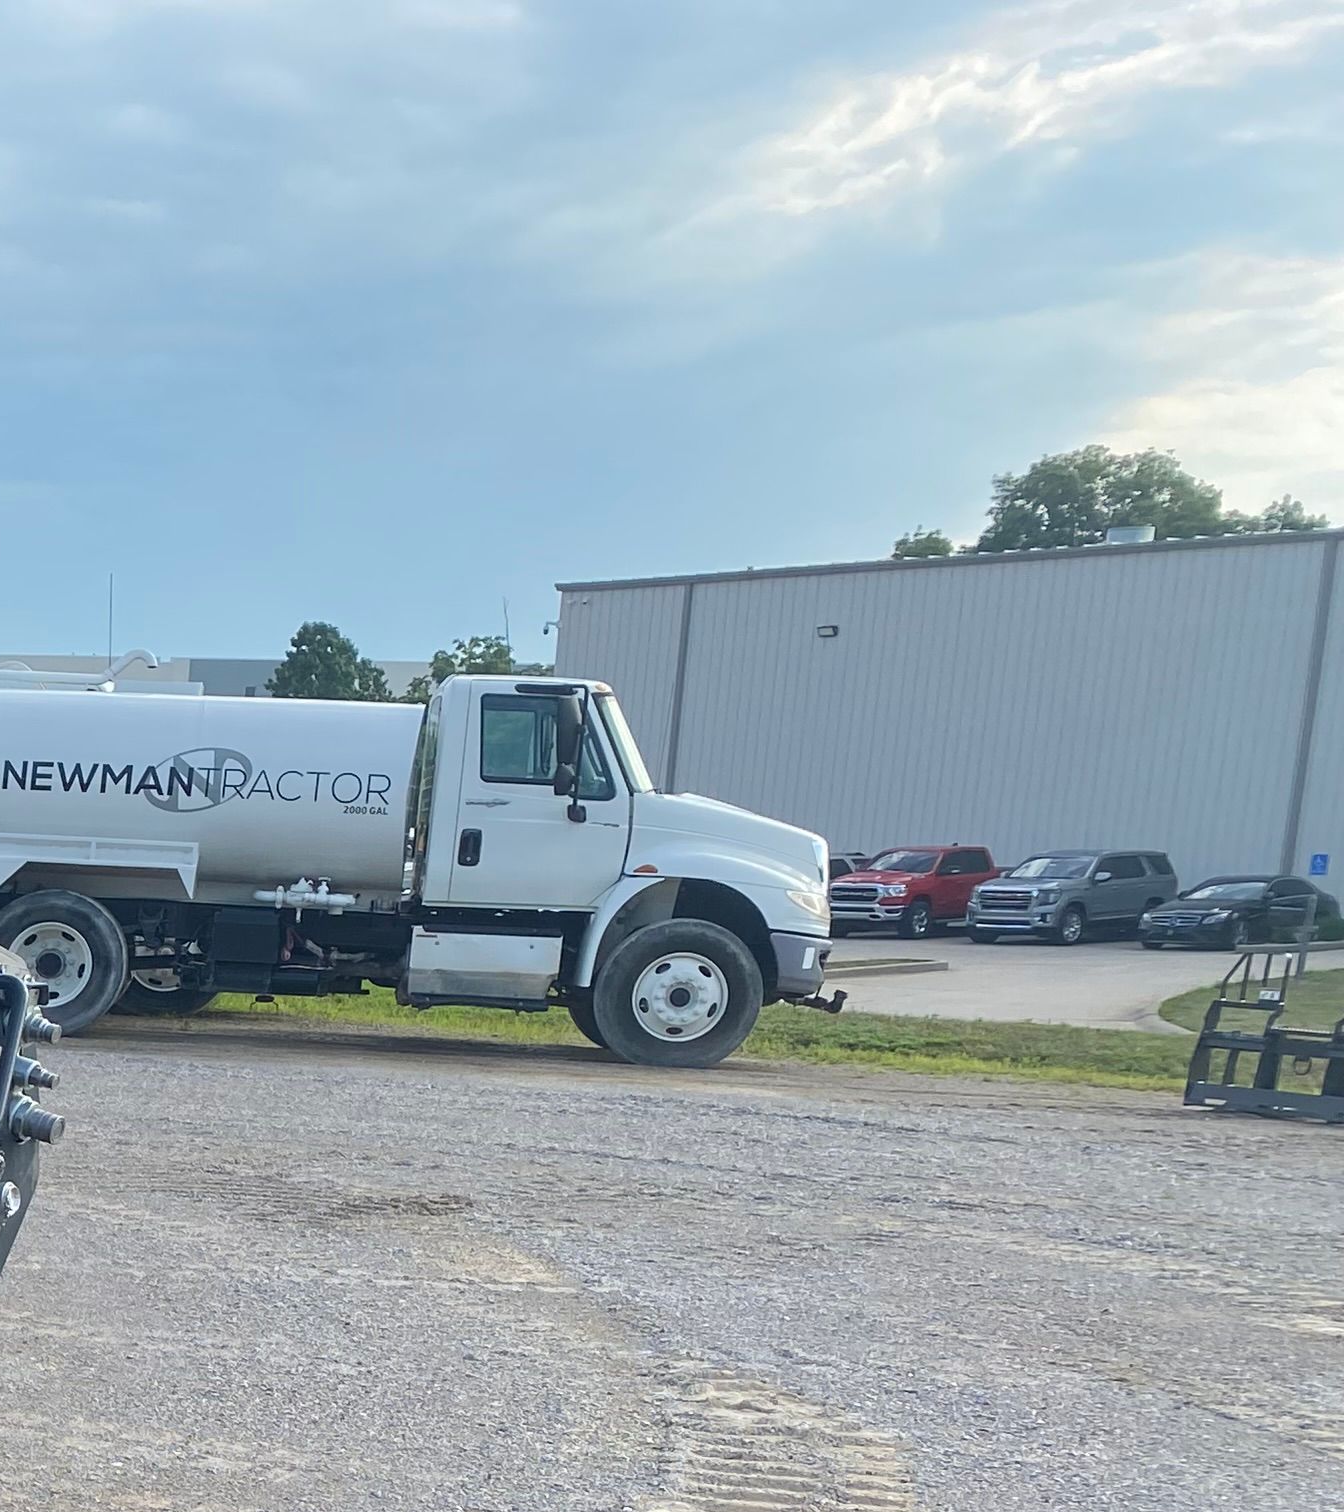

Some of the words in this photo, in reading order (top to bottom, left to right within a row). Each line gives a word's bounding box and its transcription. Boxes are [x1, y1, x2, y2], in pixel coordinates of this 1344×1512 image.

[1, 759, 392, 805] NEWMANTRACTOR
[343, 805, 368, 815] 2000
[369, 806, 389, 816] GAL
